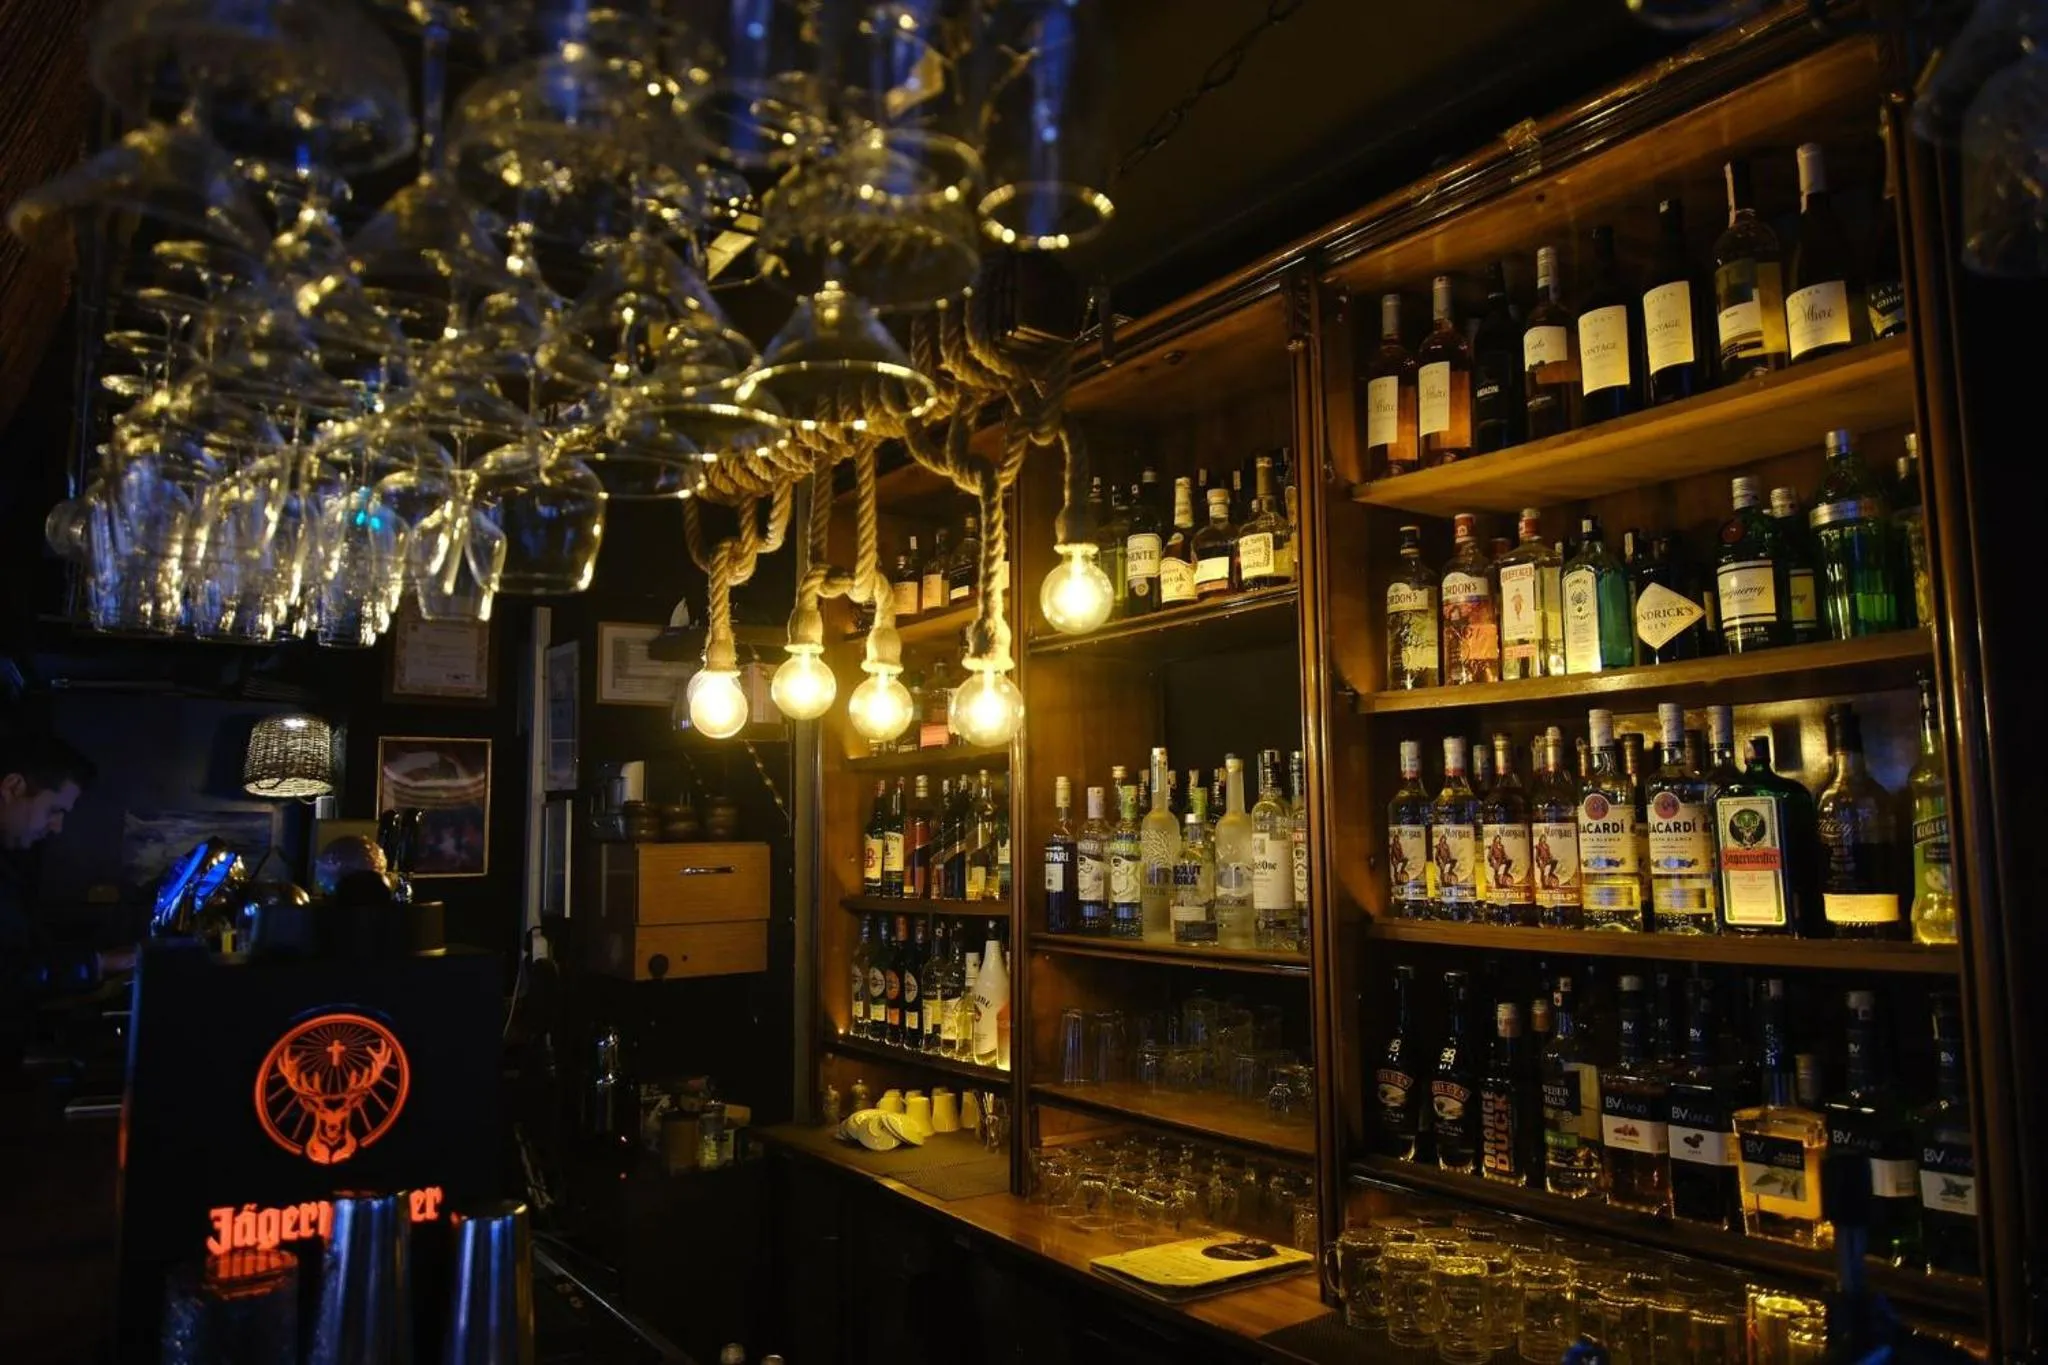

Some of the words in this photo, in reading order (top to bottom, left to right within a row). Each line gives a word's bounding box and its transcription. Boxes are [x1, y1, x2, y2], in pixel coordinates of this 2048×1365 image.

[1445, 583, 1477, 595] RDON'S
[1389, 591, 1417, 604] RDON'S
[1640, 607, 1694, 620] NDRICK'S
[1045, 851, 1069, 862] PARI
[1379, 1070, 1412, 1088] AILEYS
[1605, 1095, 1622, 1110] BV
[1672, 1105, 1689, 1120] BV
[1481, 1090, 1498, 1168] ORANGE
[1495, 1092, 1511, 1173] DUCK
[1832, 1129, 1852, 1145] BV
[1745, 1139, 1765, 1155] BV
[1923, 1147, 1945, 1164] BV
[206, 1186, 443, 1255] Jägerer
